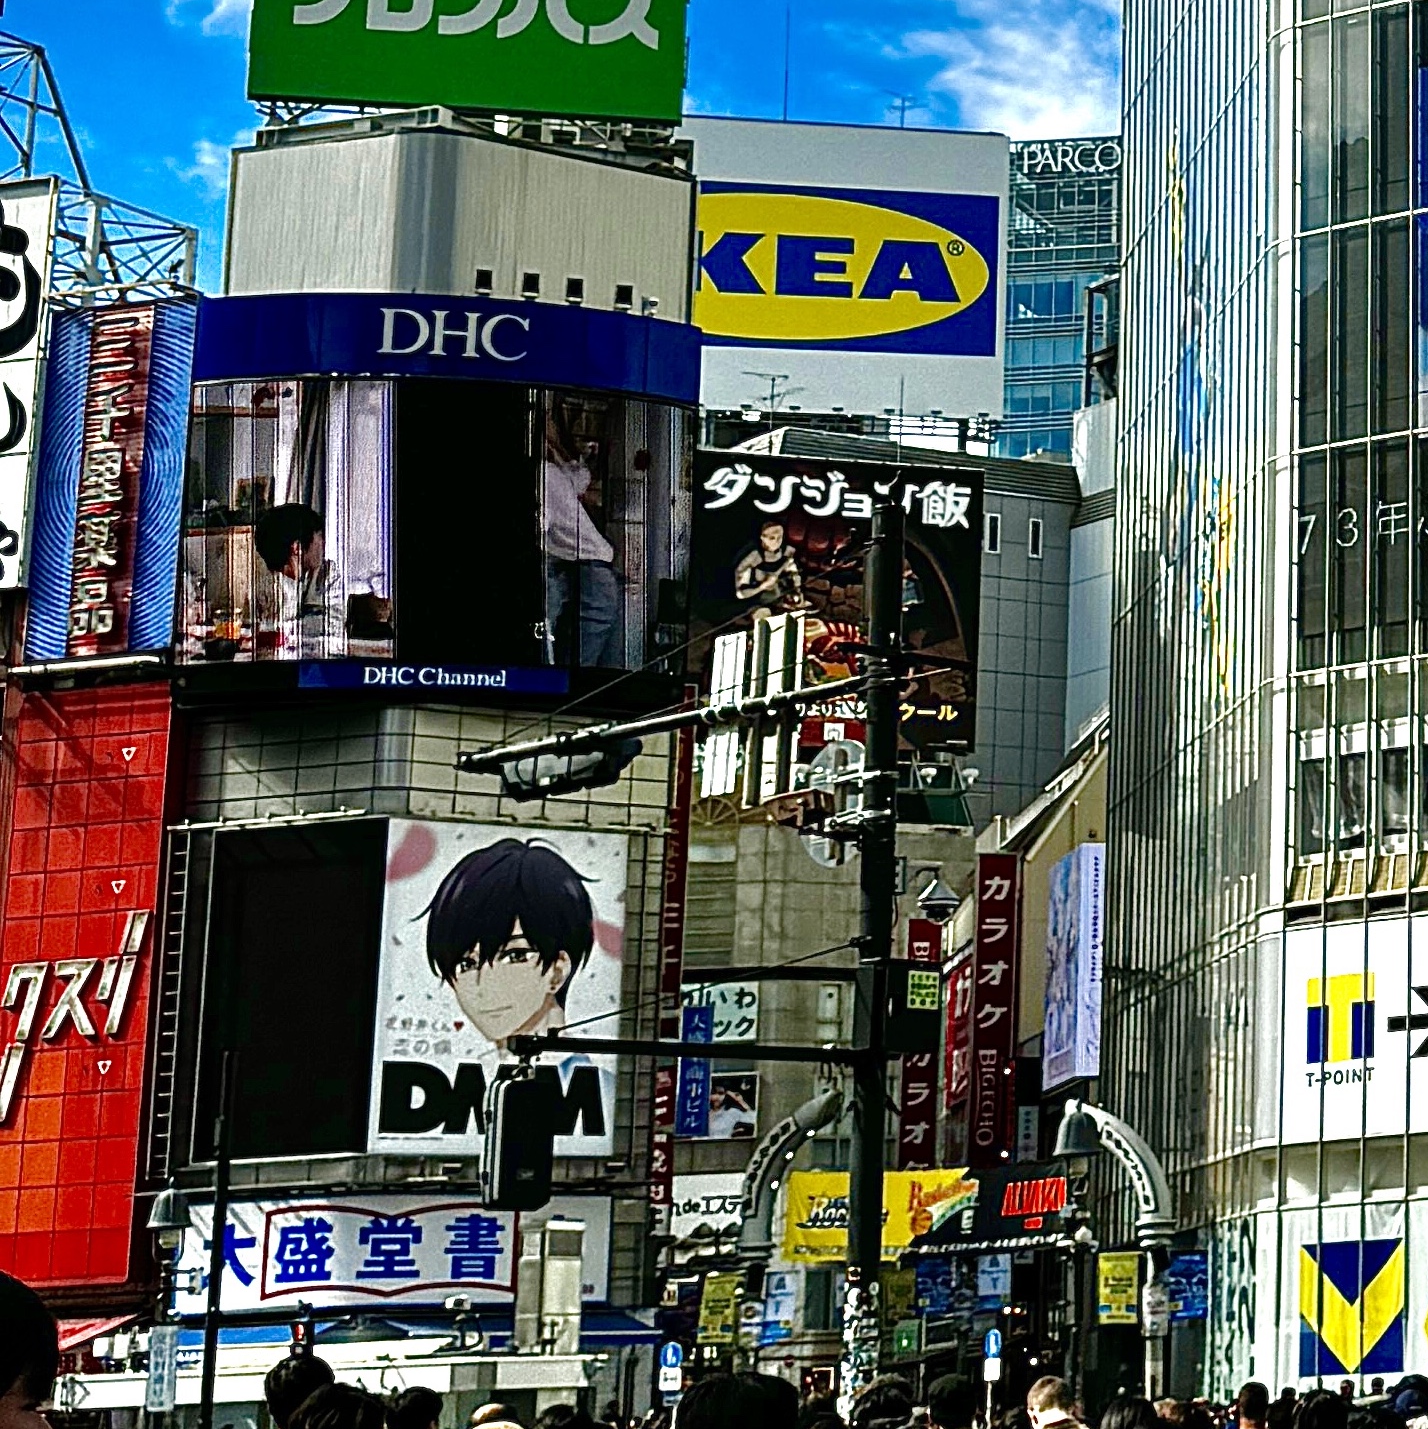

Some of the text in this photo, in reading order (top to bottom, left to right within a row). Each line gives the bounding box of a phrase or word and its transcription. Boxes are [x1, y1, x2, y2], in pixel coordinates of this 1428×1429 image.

[1023, 142, 1122, 173] PARCO
[696, 230, 962, 304] KEA
[377, 308, 531, 362] DHC
[363, 667, 507, 688] DHC Channel
[976, 875, 1012, 1030] カラオケ
[1306, 1066, 1376, 1087] T-POINT
